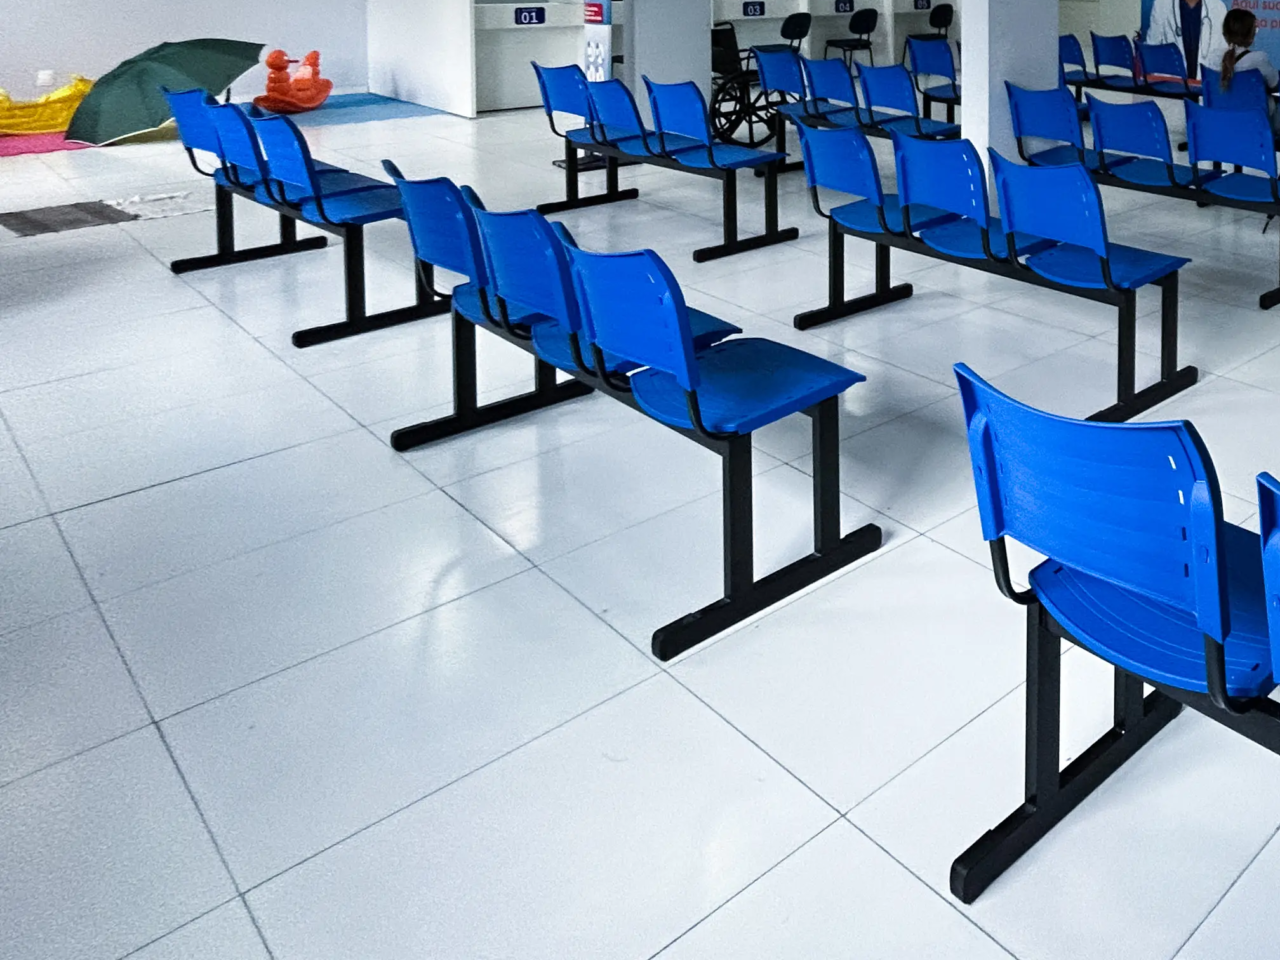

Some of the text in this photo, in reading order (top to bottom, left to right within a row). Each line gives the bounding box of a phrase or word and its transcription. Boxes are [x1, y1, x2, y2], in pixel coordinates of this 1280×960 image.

[747, 5, 761, 16] 03
[839, 3, 851, 12] 04
[521, 12, 539, 24] 01
